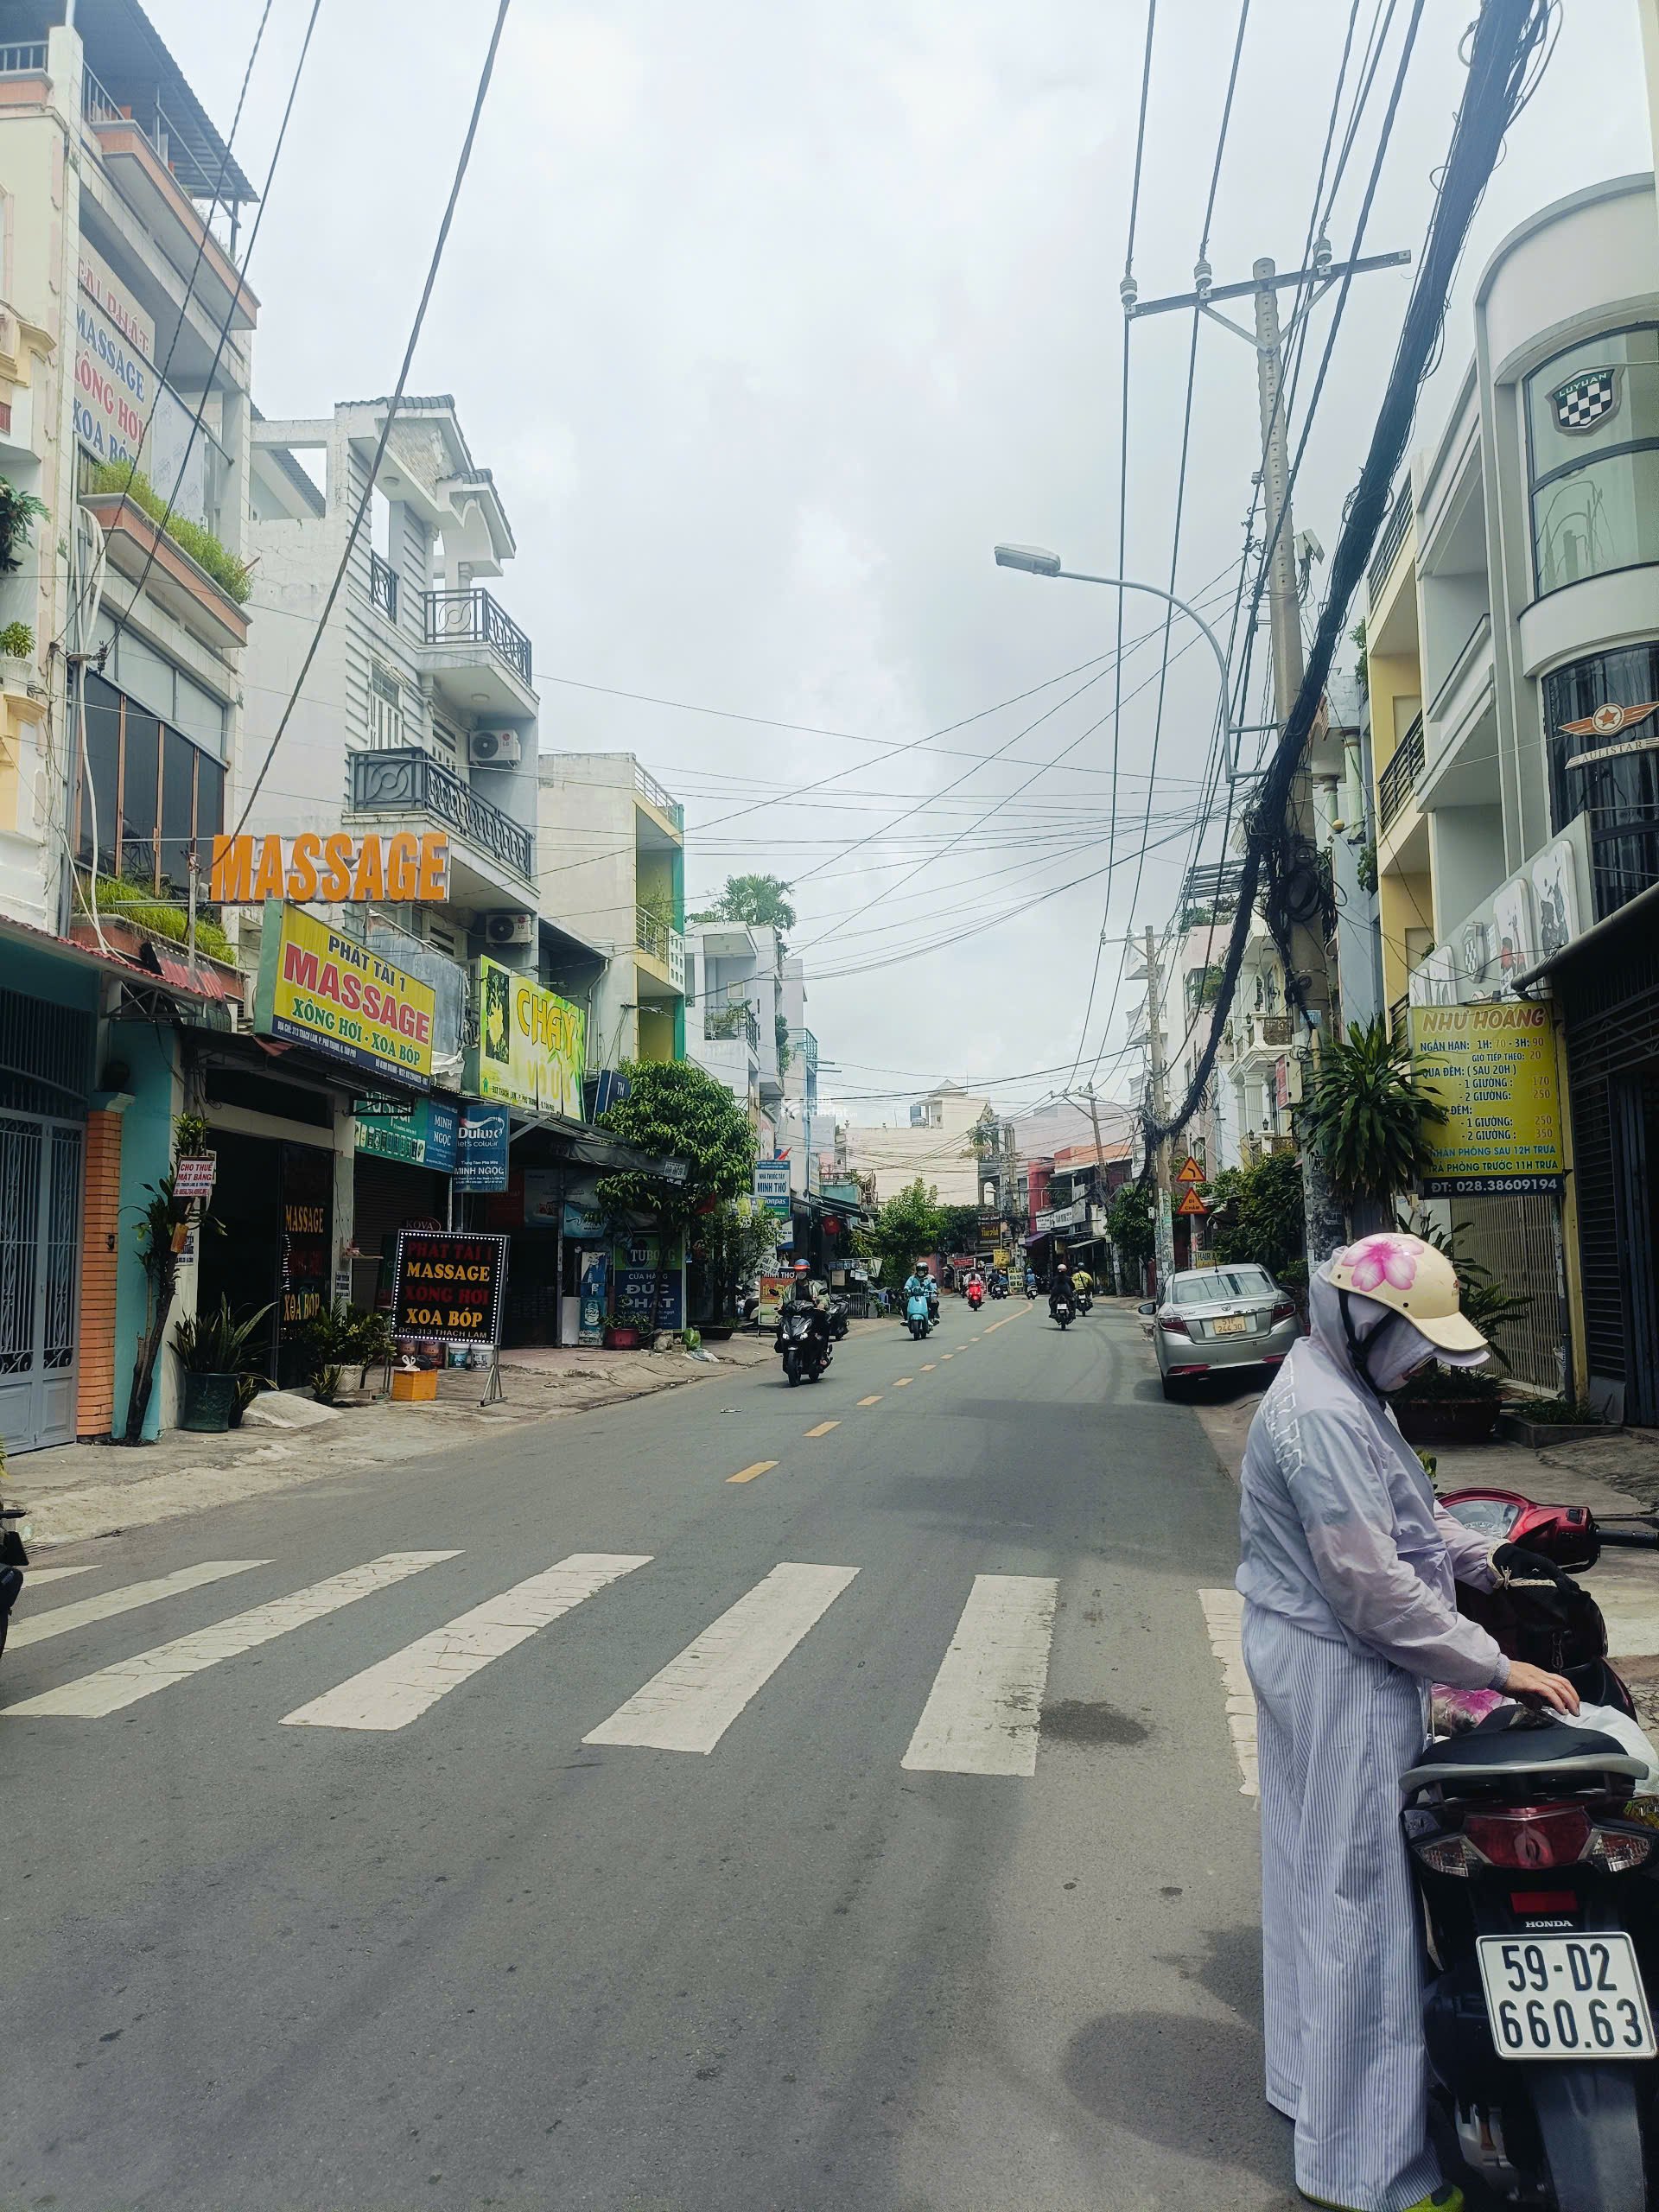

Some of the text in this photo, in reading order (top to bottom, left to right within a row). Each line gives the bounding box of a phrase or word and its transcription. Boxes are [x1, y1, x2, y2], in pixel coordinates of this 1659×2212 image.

[76, 303, 145, 404] MASSAGE
[1559, 372, 1607, 397] LUYUAN
[1582, 741, 1643, 762] AULISTAR
[211, 832, 448, 902] MASSAGE
[328, 935, 405, 993] PHÁT TÀI 1
[283, 943, 430, 1045] MASSAGE
[517, 988, 576, 1060] CHAY
[1422, 1006, 1545, 1033] NHƯ HOÀNG
[292, 997, 421, 1066] XÔNG HƠI XOA BÓP
[1447, 1041, 1470, 1053] HẠN:
[1477, 1039, 1492, 1050] 1H:
[1495, 1039, 1506, 1049] 70
[1515, 1038, 1530, 1048] 3H:
[1532, 1037, 1544, 1046] 90
[1504, 1052, 1525, 1061] THEO:
[1529, 1050, 1541, 1060] 20
[1443, 1065, 1465, 1077] ĐÊM:
[1533, 1077, 1550, 1086] 170
[1473, 1089, 1511, 1102] GIƯỜNG:
[1532, 1089, 1551, 1099] 250
[1451, 1105, 1472, 1115] ĐÊM:
[434, 1115, 453, 1130] MINH
[1475, 1116, 1513, 1127] GIƯỜNG:
[1535, 1116, 1552, 1125] 250
[433, 1130, 452, 1147] NGỌC
[458, 1127, 499, 1139] Dulux
[1535, 1128, 1553, 1138] 350
[1494, 1147, 1510, 1155] SAU
[1515, 1146, 1531, 1154] 12H
[1534, 1145, 1556, 1154] TRƯA
[454, 1166, 505, 1176] MINH NGỌC
[1446, 1160, 1479, 1172] PHÒNG
[1483, 1160, 1513, 1170] TRƯỚC
[1516, 1160, 1533, 1169] 11H
[1535, 1160, 1558, 1169] TRƯA
[757, 1181, 787, 1192] MINH THƠ
[1431, 1179, 1558, 1192] ĐT: 028.38609194
[285, 1205, 324, 1234] MASSAGE
[631, 1249, 676, 1262] TUBOG
[406, 1262, 490, 1281] MASSAGE
[284, 1294, 302, 1321] XOA
[405, 1306, 483, 1327] XOA BÓP
[1218, 1324, 1243, 1333] 244.30
[1502, 1943, 1618, 1992] 59-D2
[1499, 1999, 1643, 2049] 660.63
